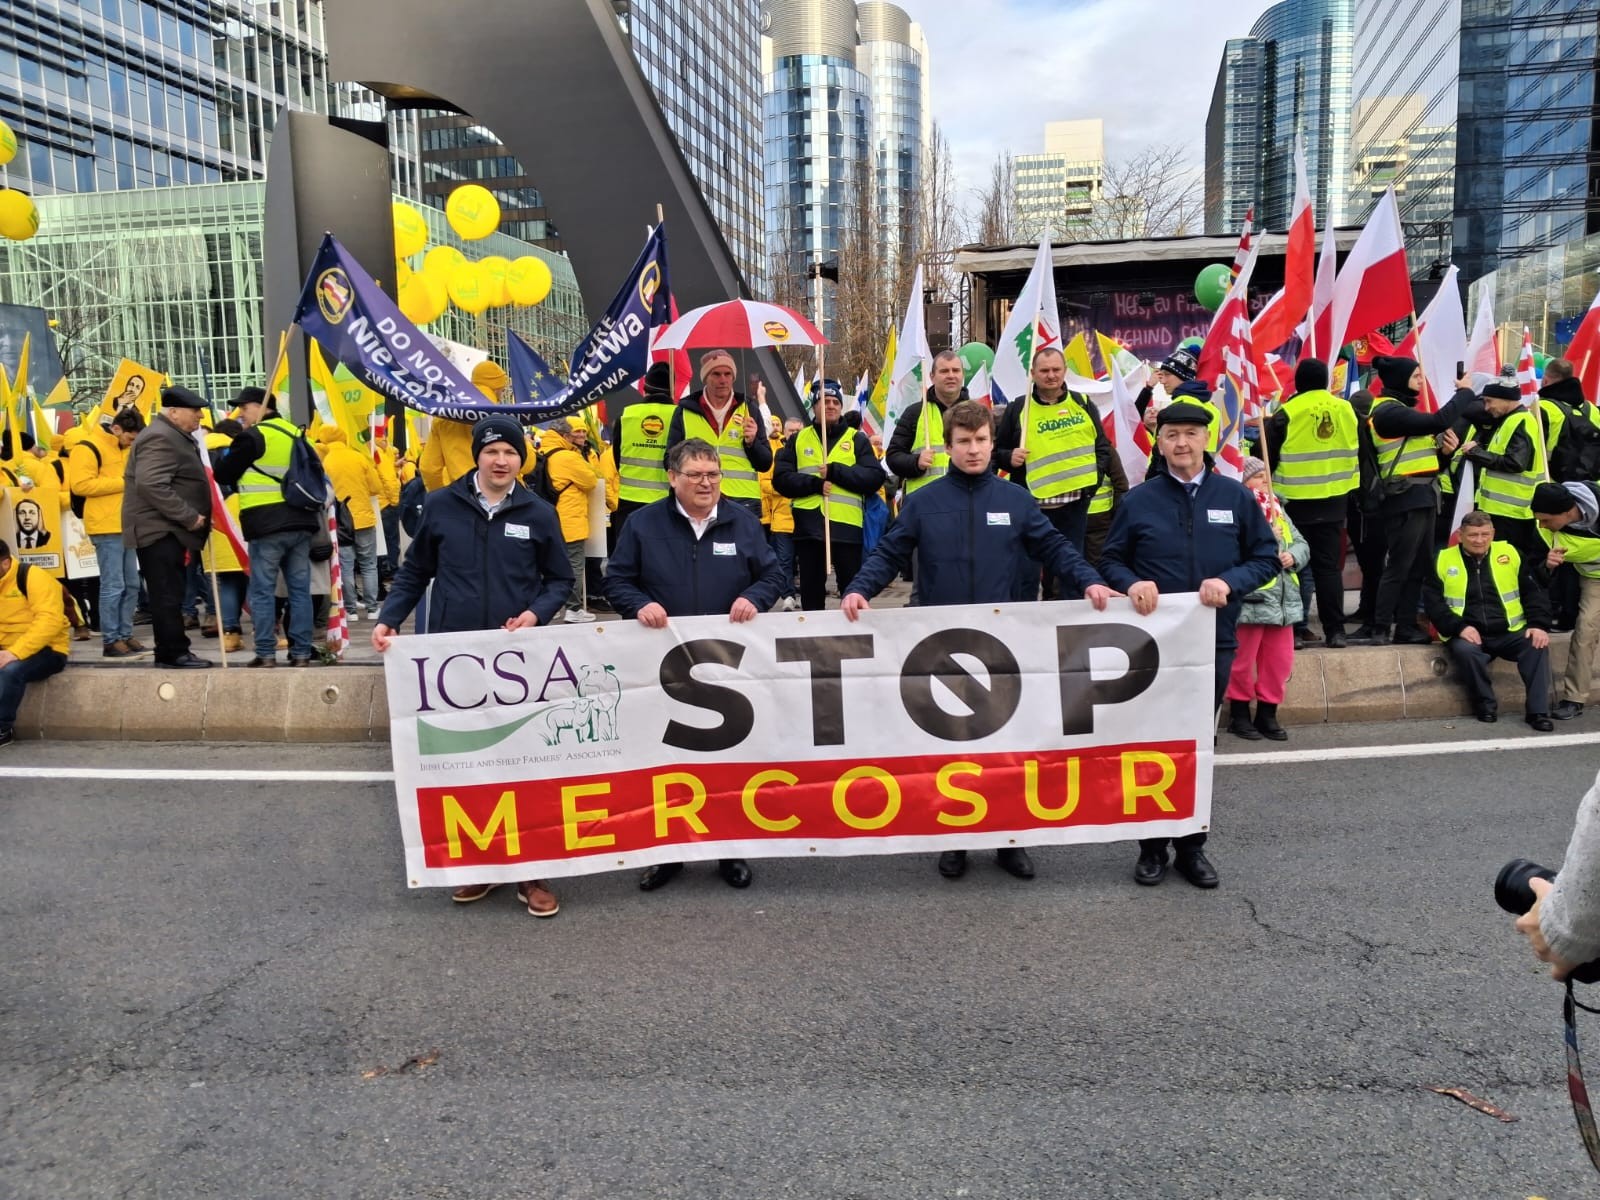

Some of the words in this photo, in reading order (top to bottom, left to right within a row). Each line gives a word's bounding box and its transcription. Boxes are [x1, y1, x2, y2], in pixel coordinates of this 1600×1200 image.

[347, 315, 393, 367] Nie
[376, 316, 411, 350] DO
[407, 350, 456, 389] NOT
[537, 368, 629, 420] ROLNICTWA
[411, 646, 578, 712] ICSA
[659, 622, 1160, 752] STOP
[442, 750, 1177, 859] MERCOSUR
